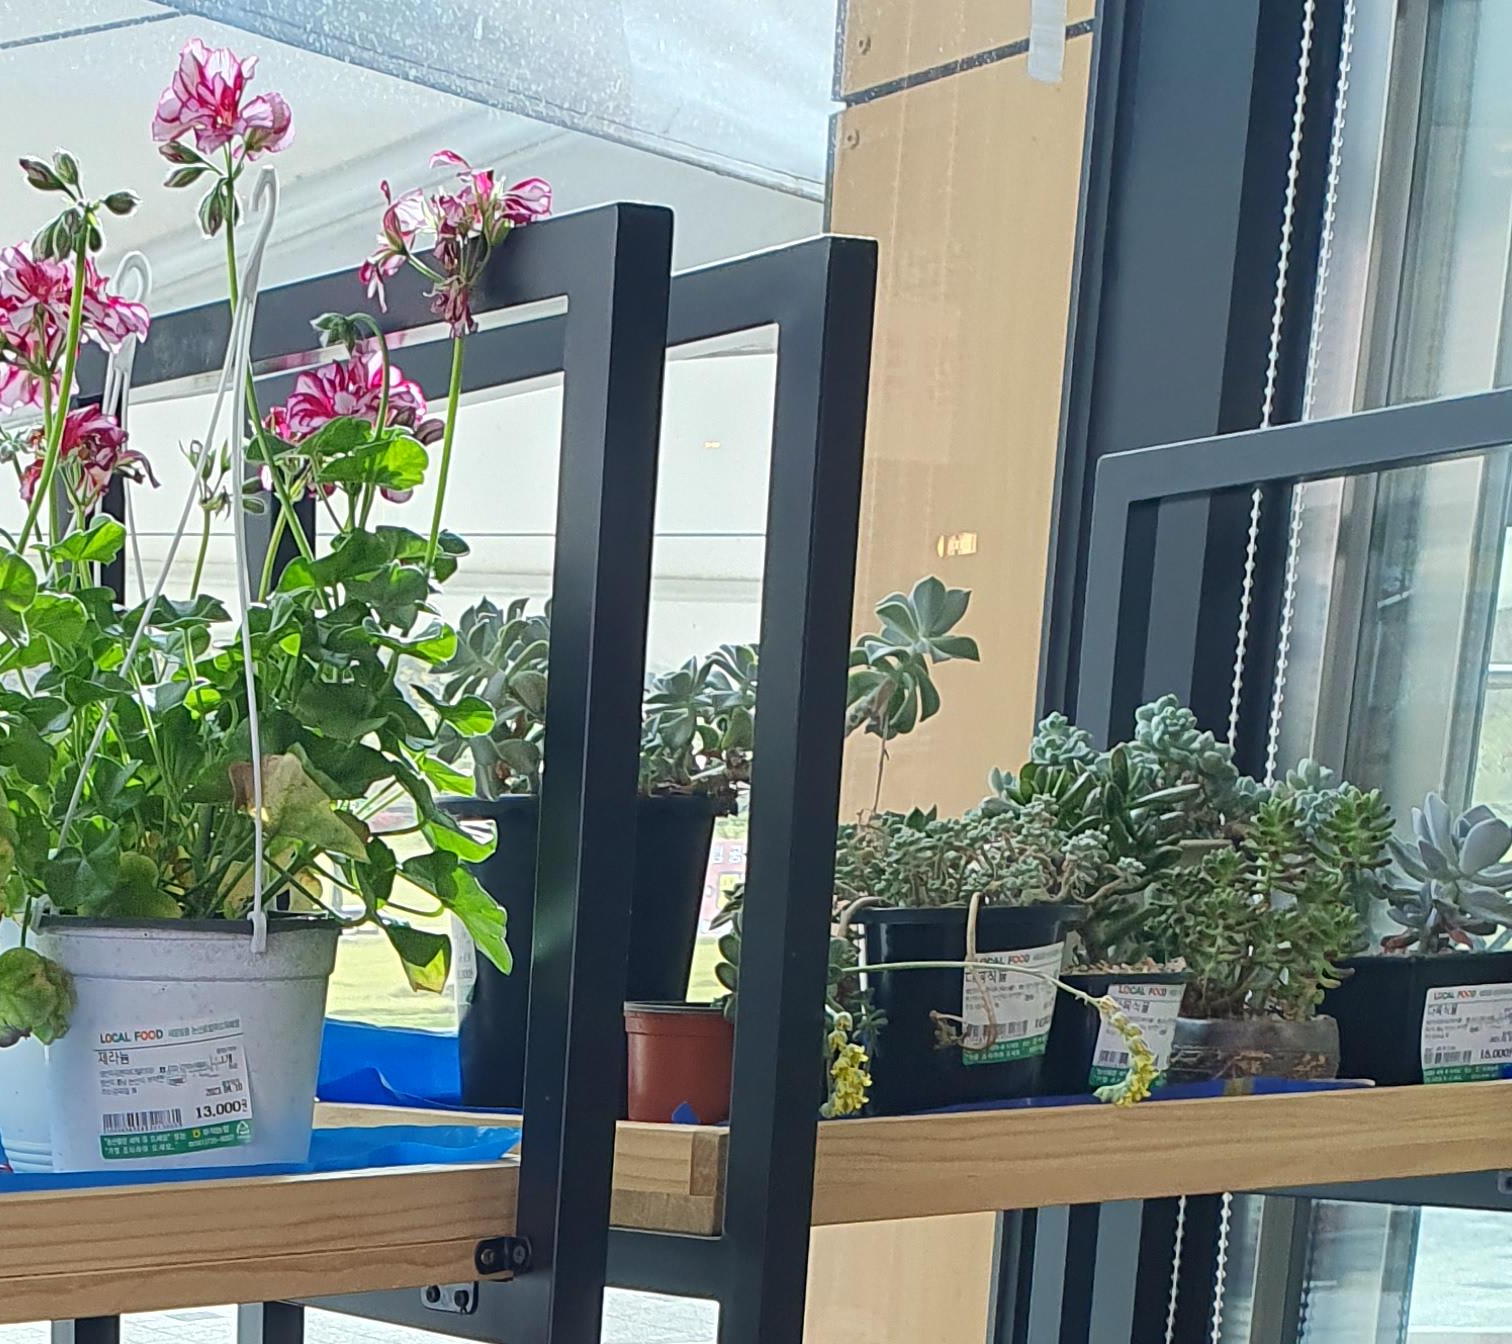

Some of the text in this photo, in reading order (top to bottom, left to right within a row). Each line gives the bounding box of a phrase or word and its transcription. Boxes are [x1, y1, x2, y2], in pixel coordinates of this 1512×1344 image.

[100, 1031, 131, 1044] LOCAL
[134, 1029, 164, 1042] FOOD
[98, 1051, 130, 1065] 제라늄
